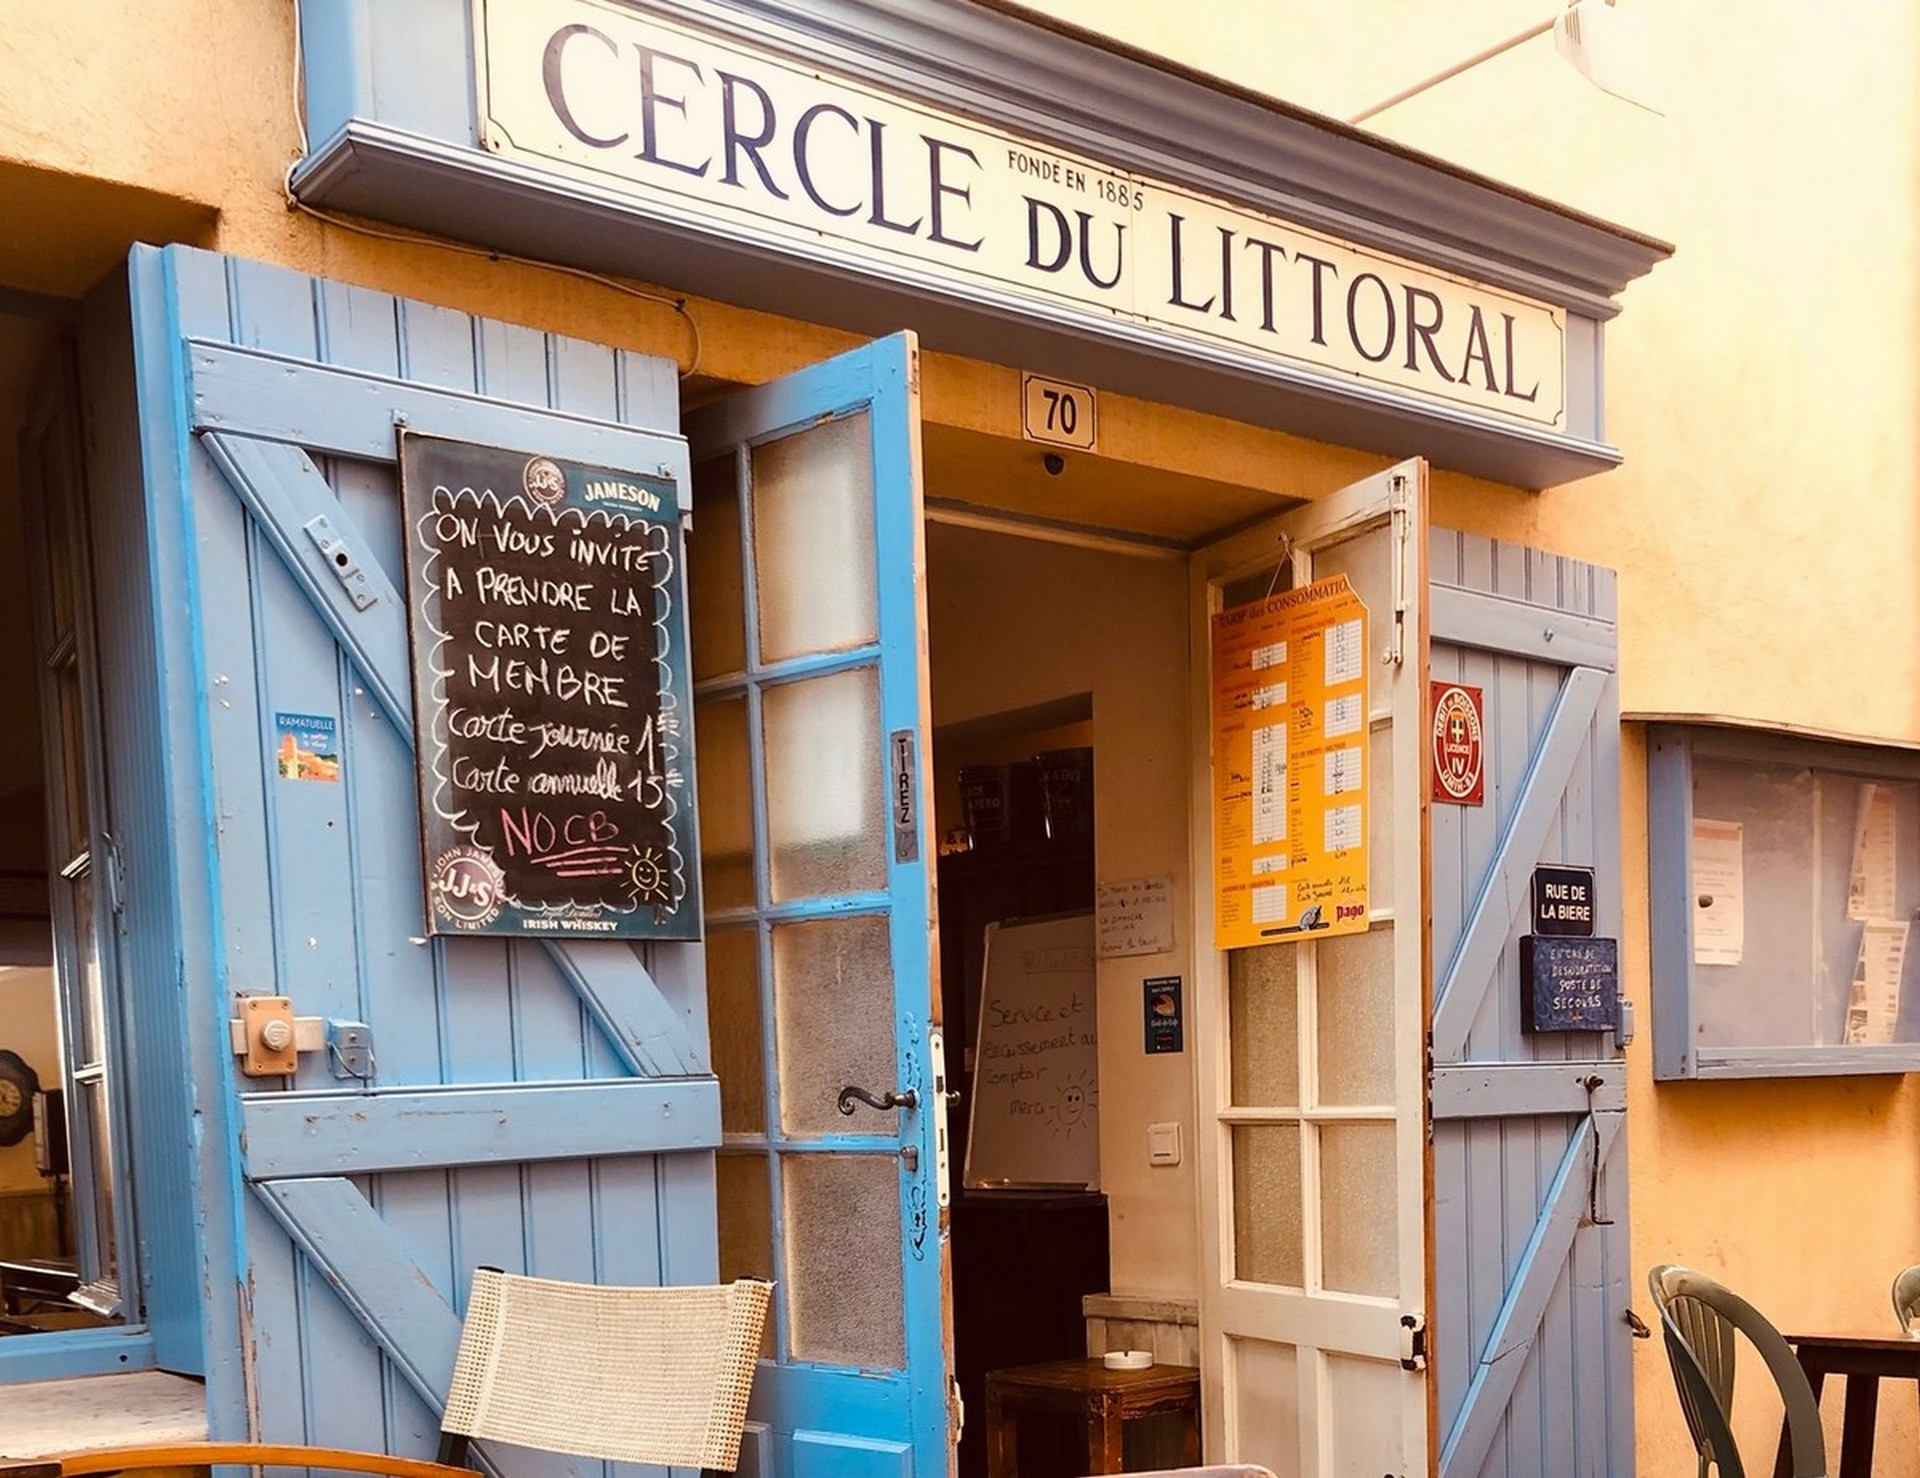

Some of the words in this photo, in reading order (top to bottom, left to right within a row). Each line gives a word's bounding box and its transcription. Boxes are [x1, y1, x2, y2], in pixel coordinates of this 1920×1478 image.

[1008, 149, 1060, 184] FONDÉ
[1066, 168, 1086, 193] EN
[1097, 178, 1144, 211] 1885
[542, 23, 985, 253] CERCLE
[1021, 194, 1127, 290] DU
[1166, 211, 1540, 403] LITTORAL
[1043, 389, 1077, 434] 70
[584, 481, 661, 513] JAMESON
[435, 513, 478, 548] ON
[446, 567, 463, 600] A
[475, 566, 594, 612] PRENDRE
[611, 588, 642, 617] LA
[1266, 578, 1349, 614] CONSOMMATIO
[475, 621, 571, 654] CARTE
[590, 632, 630, 662] DE
[450, 707, 529, 744] Carte
[453, 756, 521, 794] Carte
[898, 738, 910, 823] TIREZ
[1452, 757, 1465, 775] IV
[501, 806, 556, 856] NO
[563, 811, 620, 846] CB
[435, 847, 461, 873] JOHN
[1545, 883, 1568, 900] RUE
[1571, 885, 1586, 901] DE
[456, 907, 500, 930] LIMITED
[522, 918, 558, 931] IRISH
[561, 919, 619, 932] WHISKEY
[1335, 903, 1365, 924] pago
[1541, 905, 1556, 919] LA
[1557, 906, 1591, 922] BIERE
[1552, 995, 1602, 1010] SECOURS
